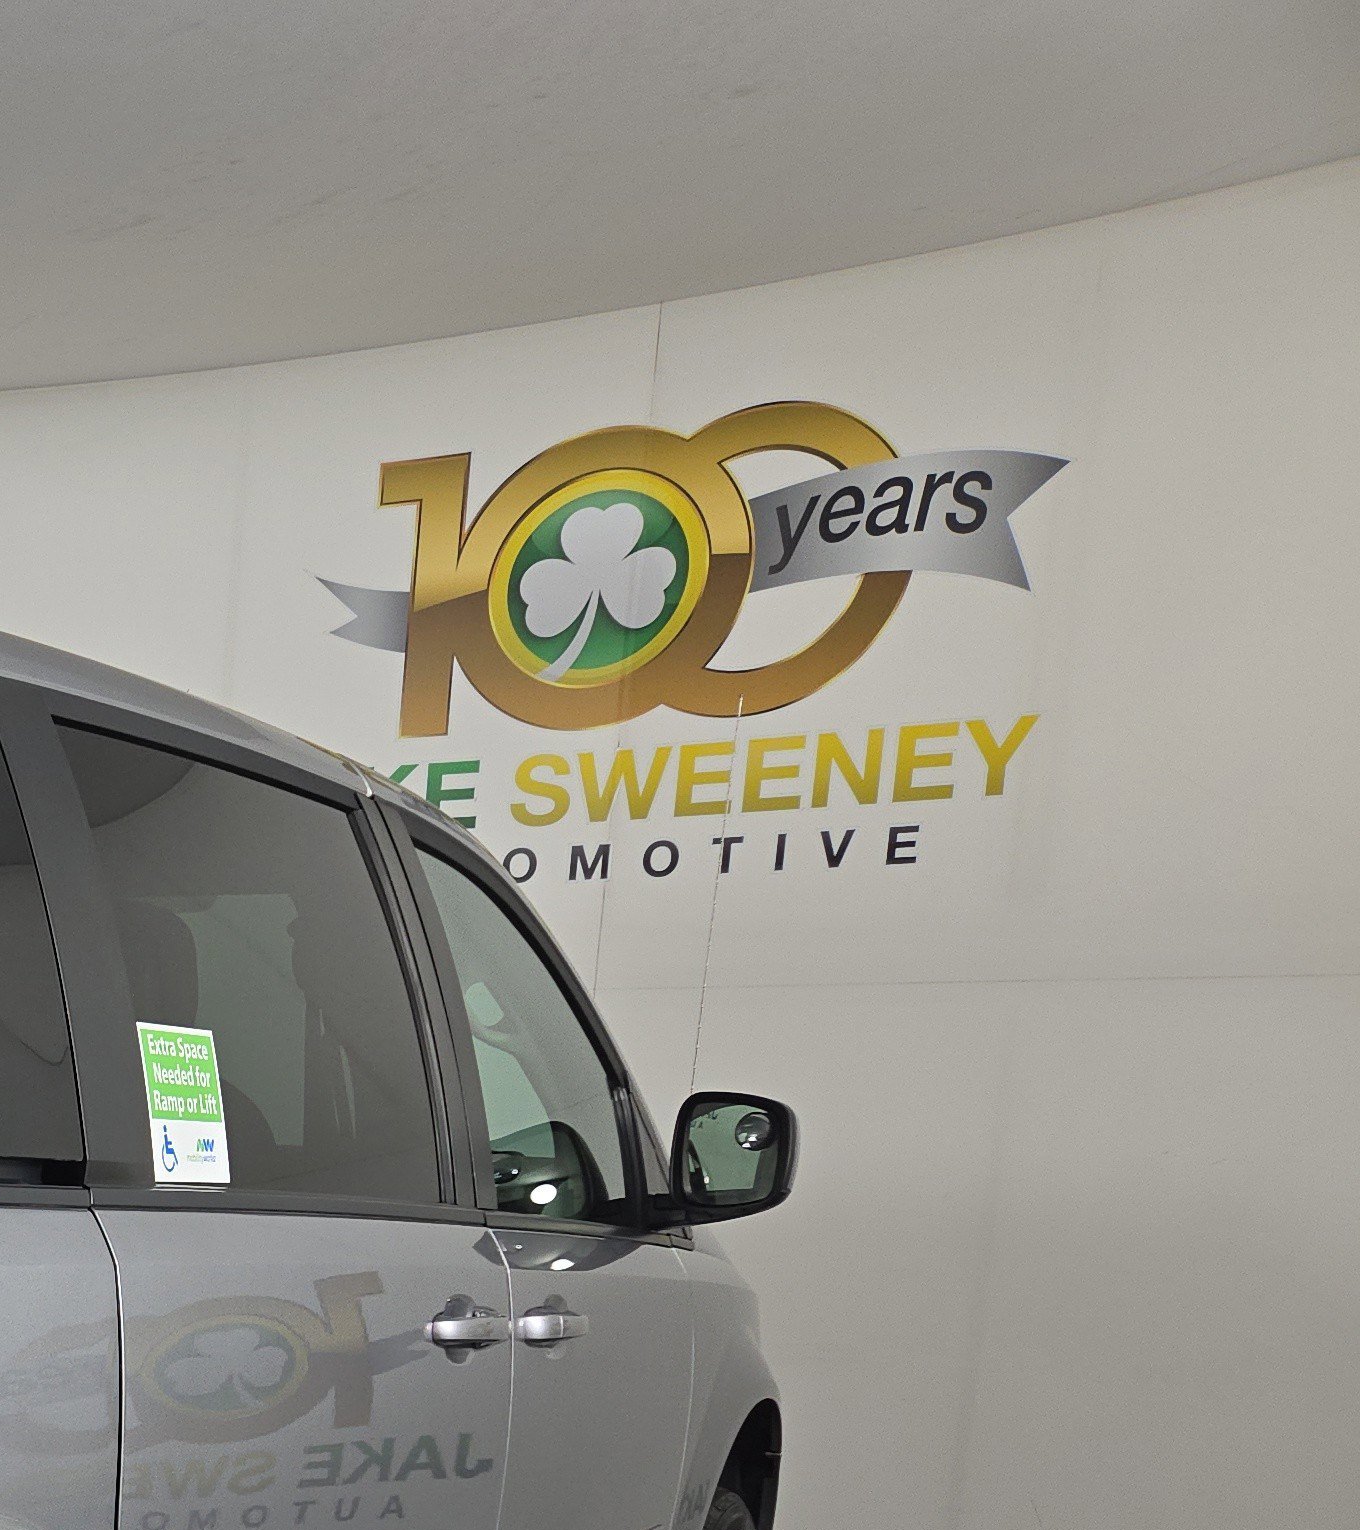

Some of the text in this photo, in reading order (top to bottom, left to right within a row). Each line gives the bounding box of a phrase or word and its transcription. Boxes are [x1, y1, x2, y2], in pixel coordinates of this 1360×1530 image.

[767, 469, 993, 576] years
[510, 713, 1039, 827] SWEENEY
[147, 1034, 209, 1064] Extra Space
[152, 1062, 211, 1088] Needed for
[153, 1090, 218, 1117] Ramp or Lift
